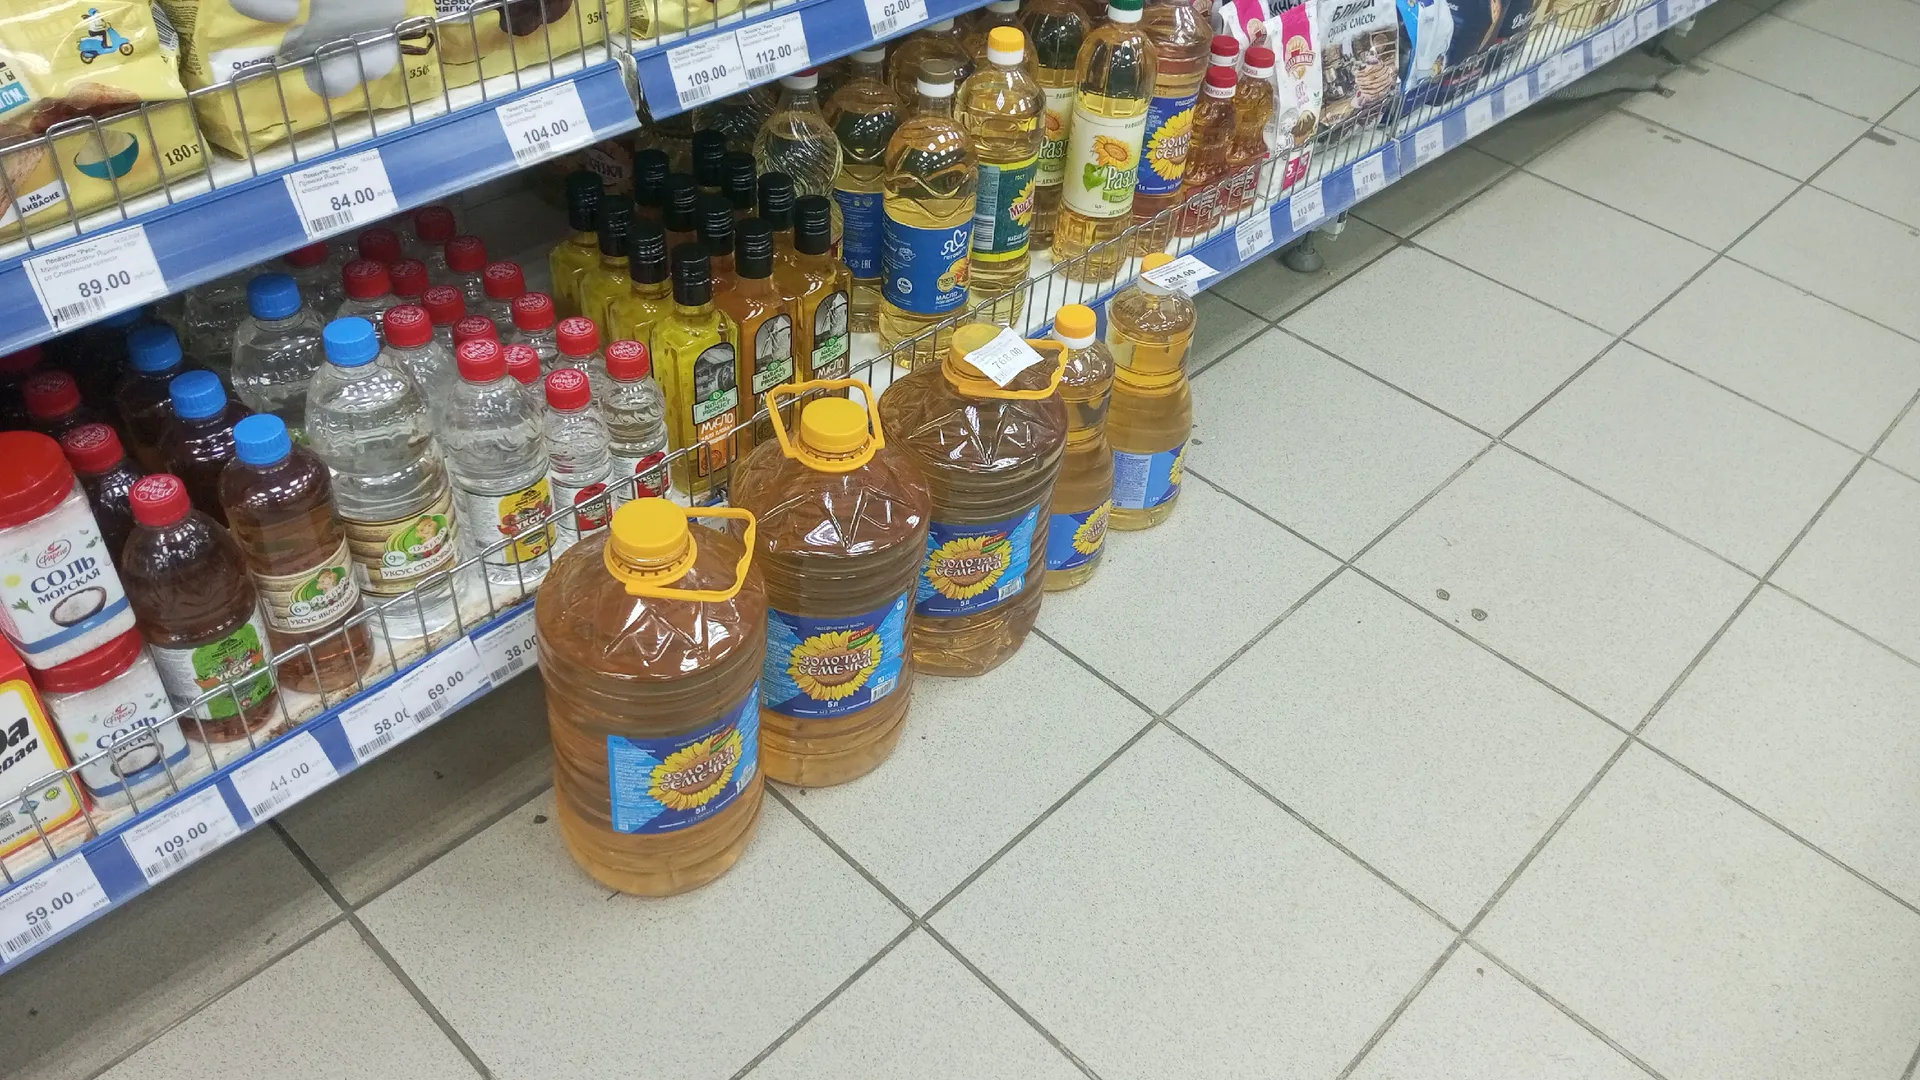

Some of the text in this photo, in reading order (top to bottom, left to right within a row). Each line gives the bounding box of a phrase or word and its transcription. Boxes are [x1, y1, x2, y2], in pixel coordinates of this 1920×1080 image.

[884, 0, 910, 17] 62.00
[756, 44, 792, 64] 112.00
[688, 64, 727, 87] 109.00
[523, 119, 569, 144] 104.00
[21, 192, 60, 214] АКВАСКЕ
[29, 193, 42, 202] НА
[330, 187, 375, 211] 84.00
[79, 270, 130, 298] 89.00
[701, 412, 734, 435] МАСЛО
[516, 511, 546, 530] УКСУС
[383, 567, 412, 578] УКСУС
[935, 560, 1003, 578] СЕМЕЧКА
[939, 553, 1003, 569] ЗОЛОТАЯ
[30, 556, 96, 594] СОЛЬ
[37, 568, 101, 605] МОРСКАЯ
[290, 614, 317, 626] УКСУС
[798, 658, 872, 676] СЕМЕЧКА
[800, 649, 872, 667] ЗОЛОТАЯ
[216, 659, 253, 682] УКСУС
[427, 670, 465, 701] 69.00
[660, 753, 736, 792] СЕМЕЧКА
[661, 744, 735, 783] ЗОЛОТАЯ
[270, 762, 310, 792] 44.00
[155, 822, 208, 858] 109.00
[26, 891, 74, 926] 59.00
